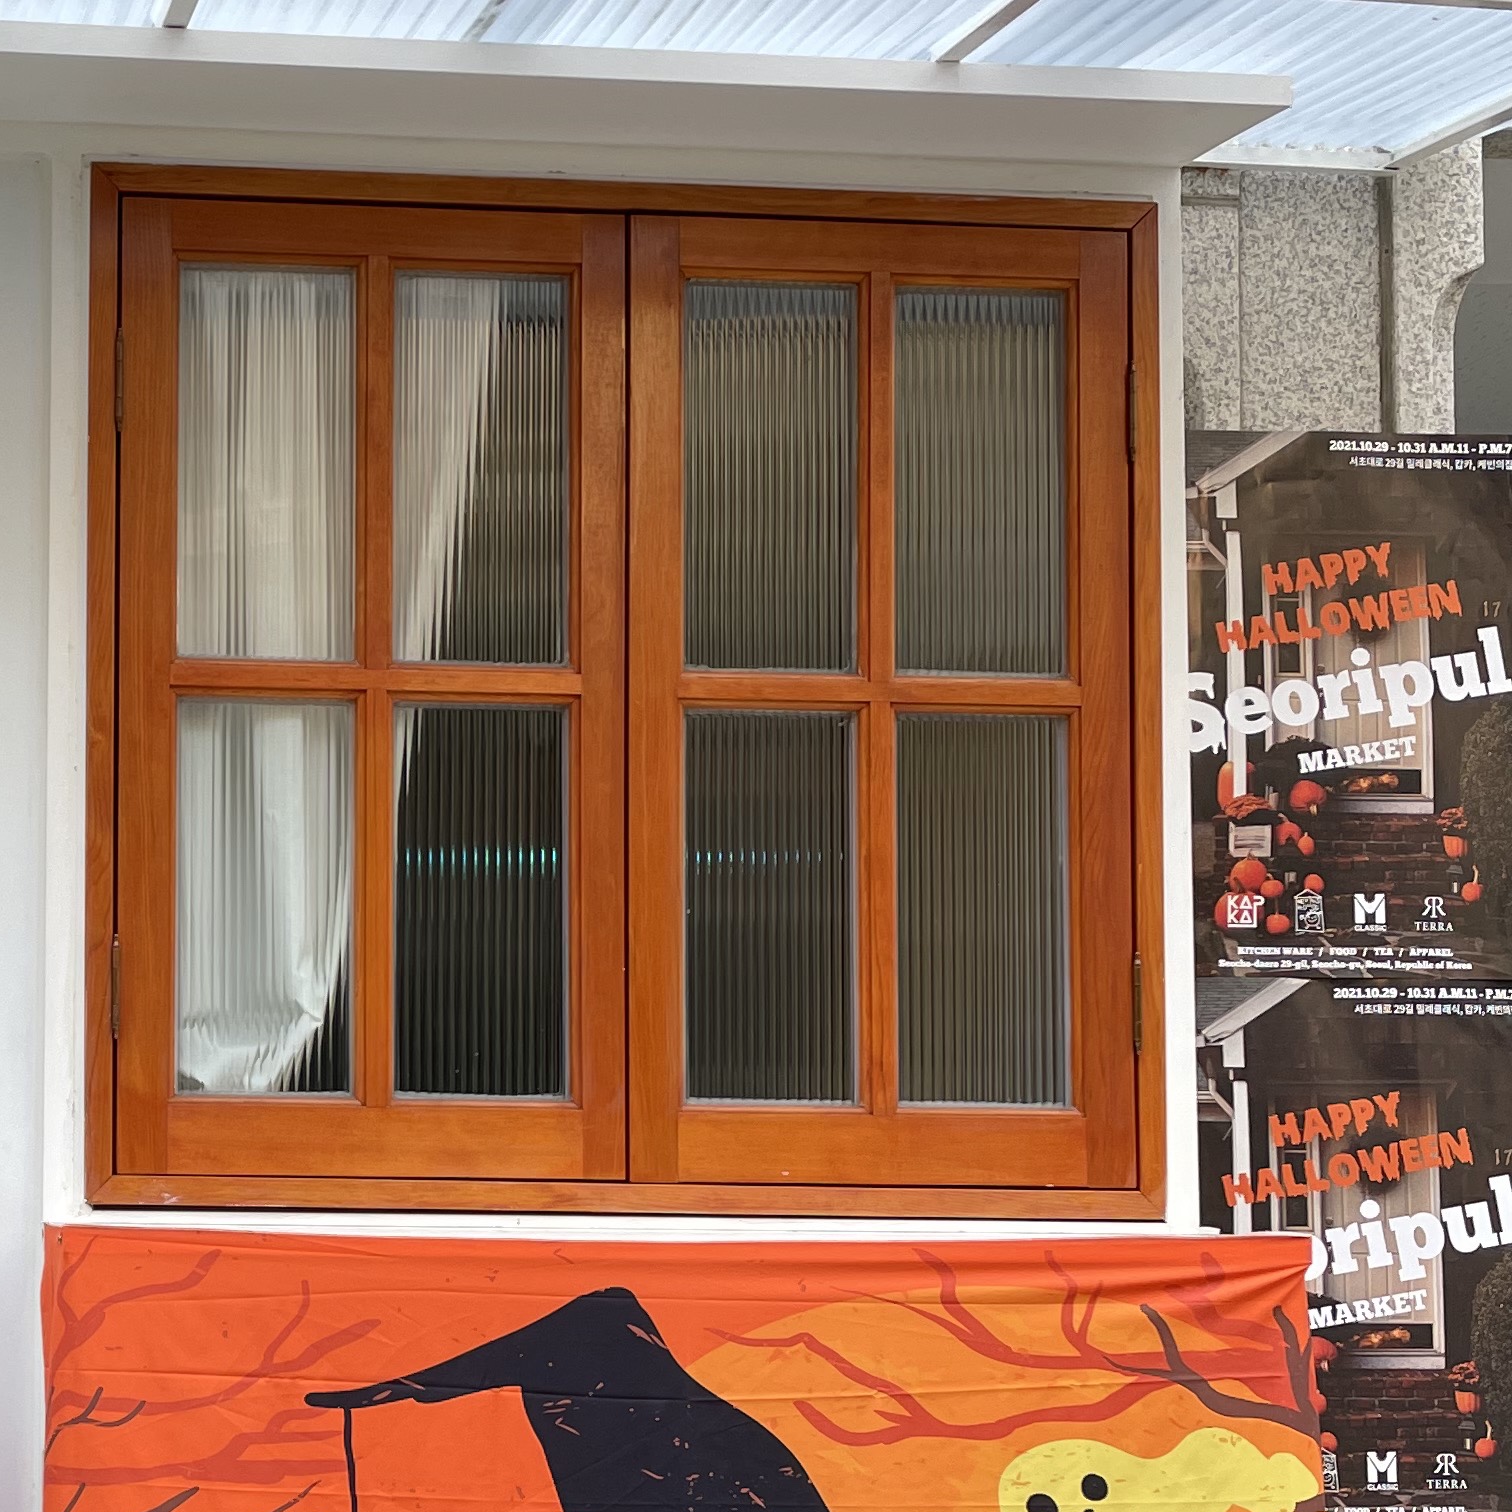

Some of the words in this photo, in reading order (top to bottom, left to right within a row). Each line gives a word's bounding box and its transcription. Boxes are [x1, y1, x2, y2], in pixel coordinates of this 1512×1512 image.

[1329, 440, 1389, 453] 2021.10.29
[1397, 442, 1427, 454] 10.31
[1428, 442, 1470, 455] A.M.11
[1262, 542, 1391, 596] HAPPY
[1215, 579, 1463, 654] HALLOWEEN
[1188, 626, 1512, 755] Seoripul
[1297, 736, 1417, 774] MARKET
[1414, 921, 1454, 932] TERRA
[1333, 987, 1398, 999] 2021.10.29
[1407, 987, 1436, 999] 10.31
[1437, 987, 1478, 999] A.M.11
[1268, 1091, 1400, 1148] HAPPY
[1221, 1127, 1474, 1207] HALLOWEEN
[1309, 1289, 1427, 1330] MARKET
[1426, 1479, 1468, 1490] TERRA
